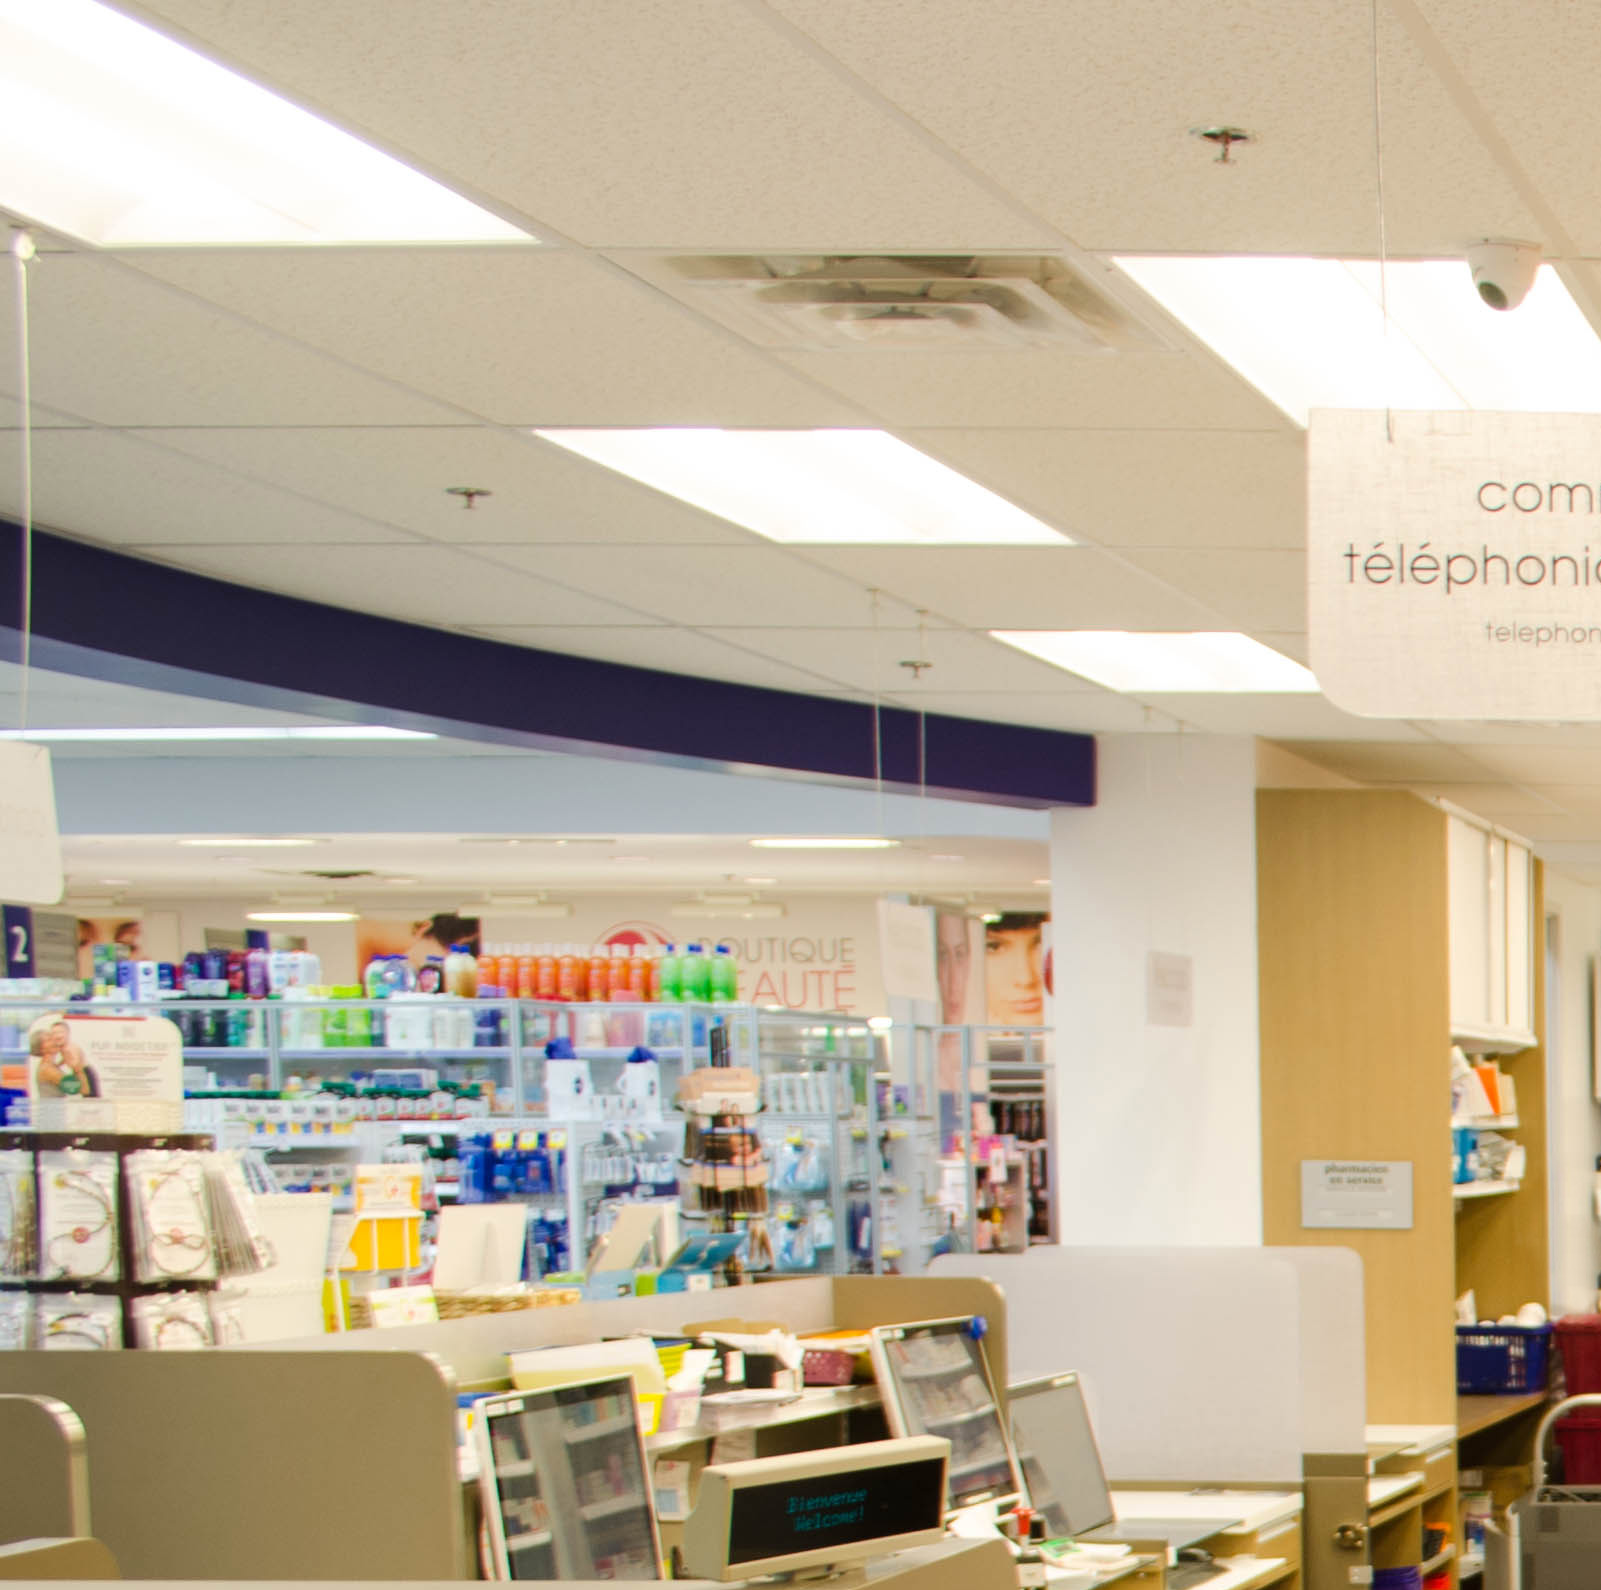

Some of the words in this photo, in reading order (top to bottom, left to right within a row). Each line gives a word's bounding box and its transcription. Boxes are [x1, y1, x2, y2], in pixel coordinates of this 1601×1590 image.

[11, 925, 29, 963] 2
[737, 965, 856, 1010] AUTÉ
[785, 1488, 868, 1514] Bienvenue
[794, 1503, 865, 1532] Welcome!
